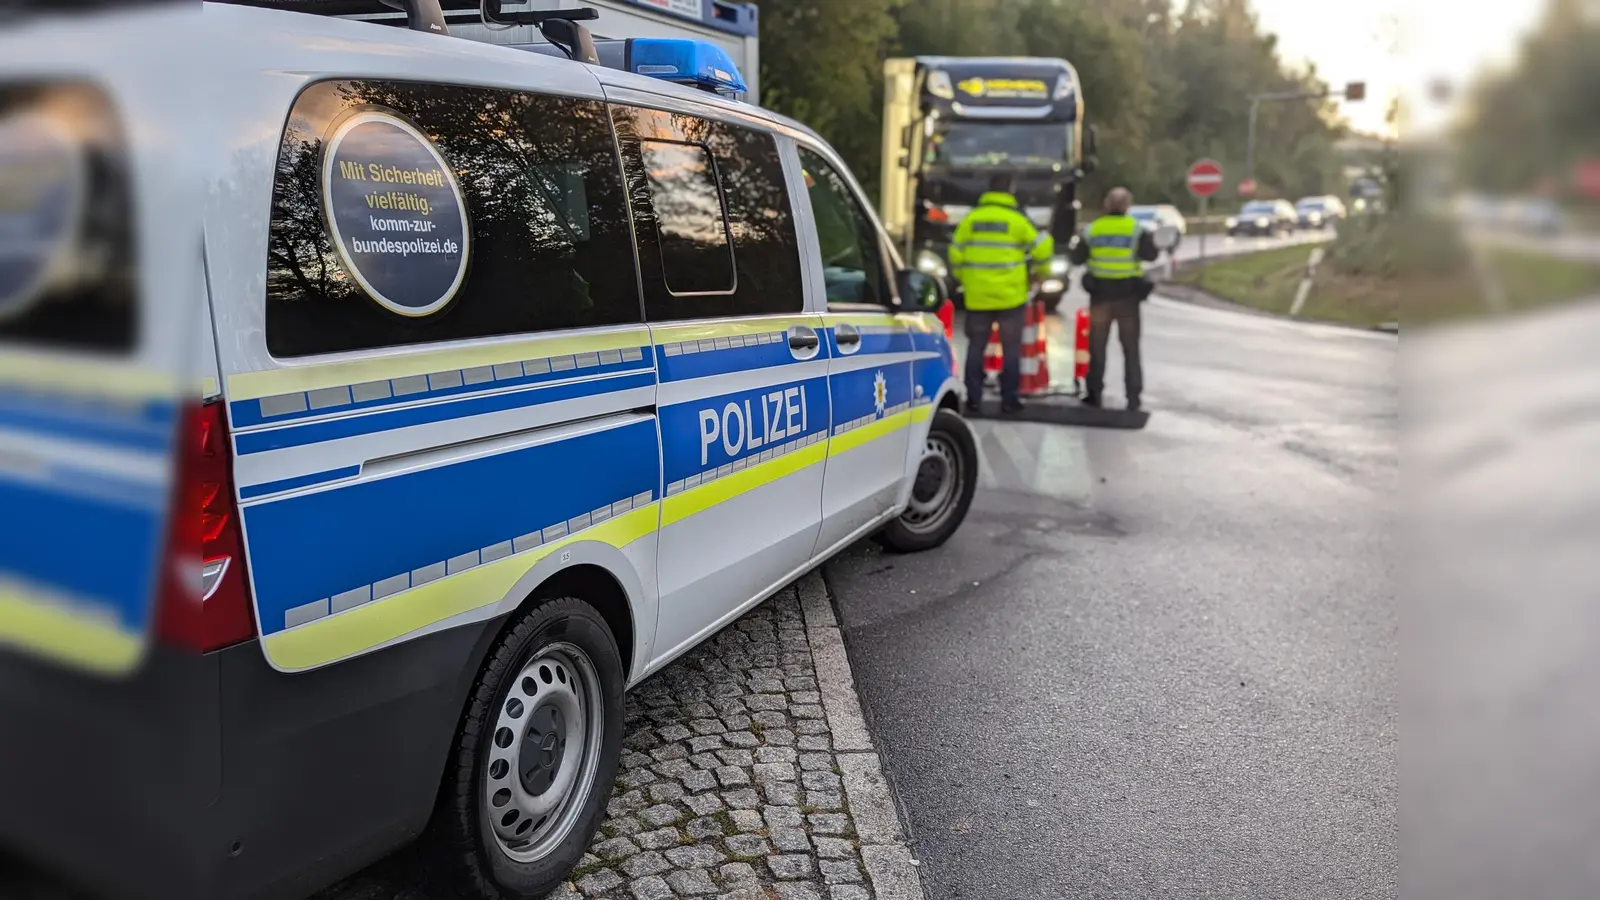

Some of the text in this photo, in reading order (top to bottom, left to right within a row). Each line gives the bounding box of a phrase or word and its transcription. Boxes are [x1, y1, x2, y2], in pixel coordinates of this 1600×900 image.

[340, 161, 443, 187] Mit Sicherheit
[365, 191, 433, 215] vielfältig.
[370, 215, 436, 232] komm-zur-
[352, 237, 458, 256] bundespolizei.de
[699, 385, 807, 465] POLIZEI
